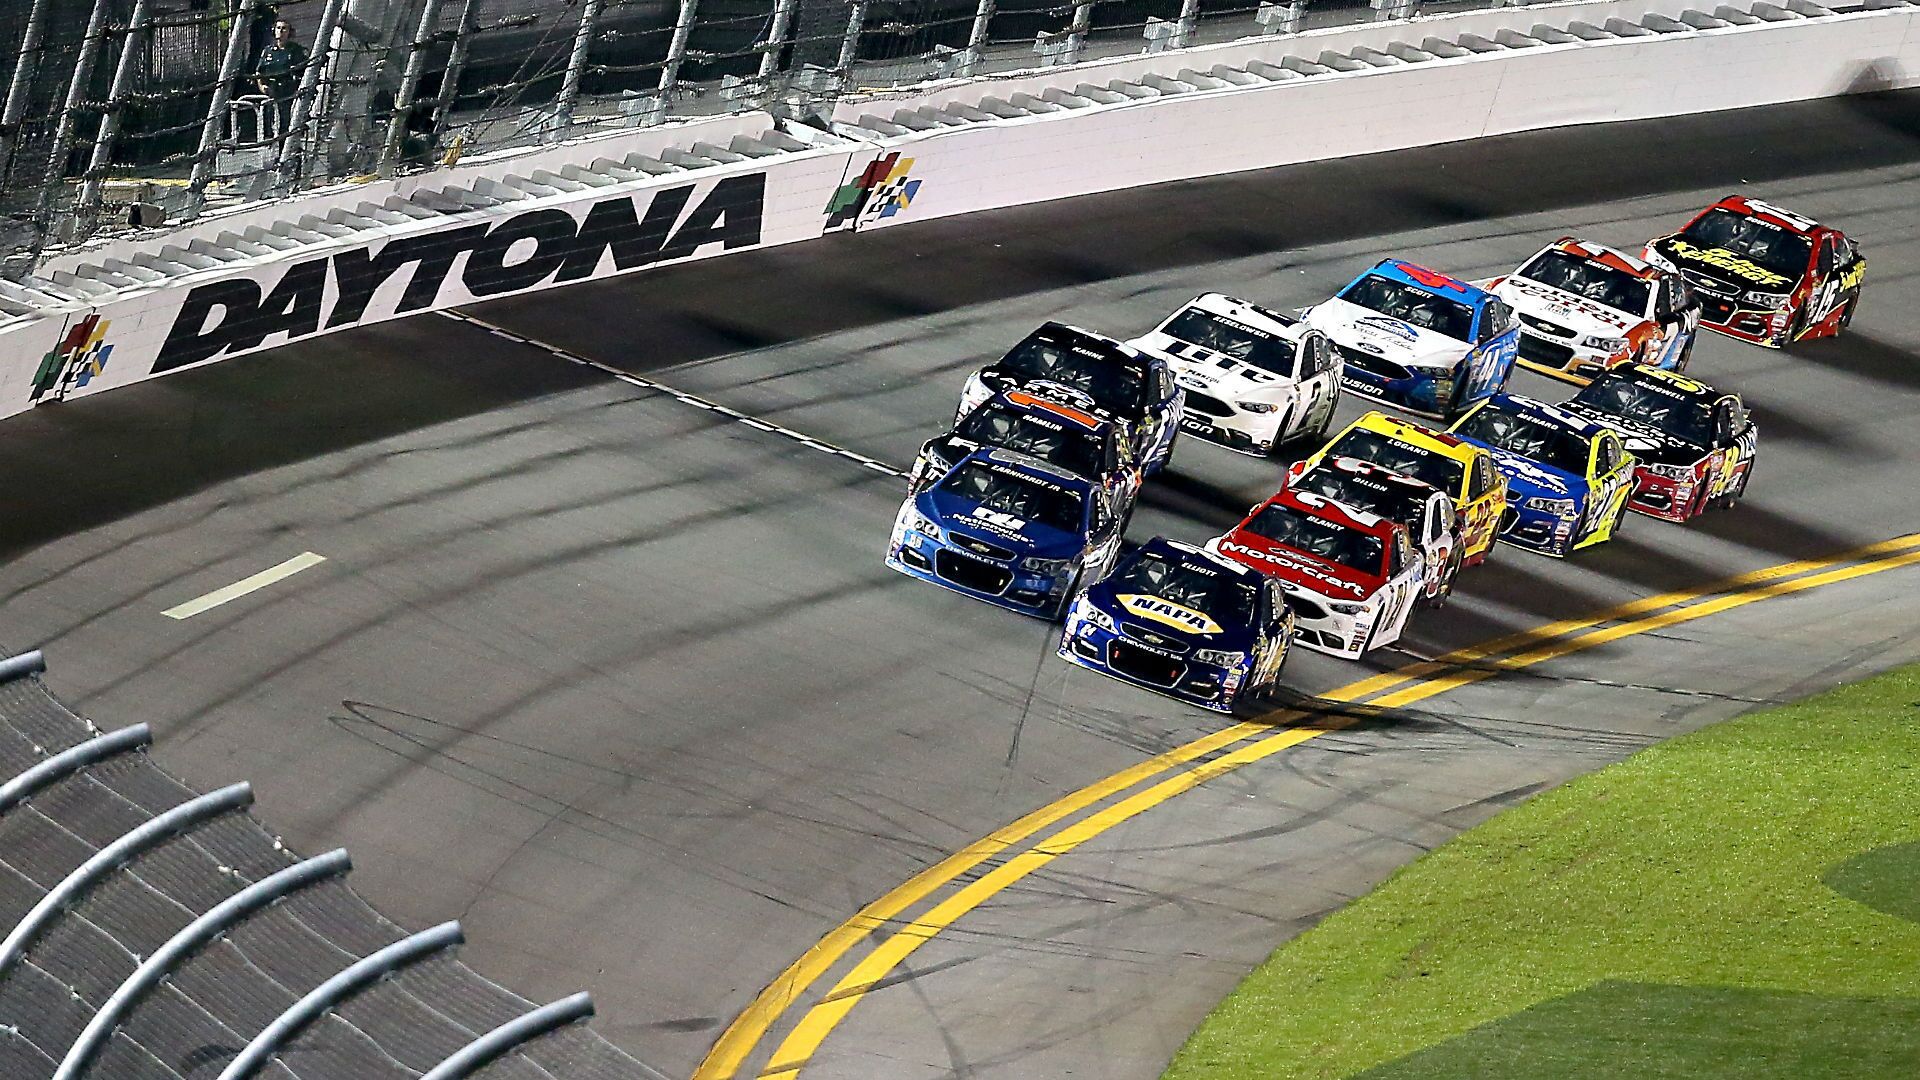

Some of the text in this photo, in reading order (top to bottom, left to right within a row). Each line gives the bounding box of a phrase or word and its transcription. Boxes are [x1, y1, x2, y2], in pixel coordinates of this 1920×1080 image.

[1744, 216, 1782, 232] BOWYER
[151, 172, 767, 374] DAYTONA
[1584, 259, 1614, 272] SMITH
[1403, 286, 1434, 299] SCOTT
[1212, 316, 1269, 340] KESELOWSKI
[1072, 346, 1106, 360] KAHNE
[1022, 414, 1063, 431] HAMLIN
[1516, 413, 1559, 430] MENARD
[1566, 402, 1705, 452] THRIVENT
[1386, 438, 1429, 456] LOGANO
[991, 463, 1048, 488] EARNHARDT
[1048, 482, 1062, 492] JR
[1353, 477, 1388, 492] DILLON
[953, 513, 1030, 543] Nationwide
[1306, 515, 1345, 532] BLANEY
[945, 544, 995, 565] CHEVROLET
[1181, 562, 1218, 577] ELLIOTT
[1221, 541, 1365, 597] Motorcraft
[1133, 597, 1207, 630] NAPA
[1118, 635, 1169, 657] CHEVROLET
